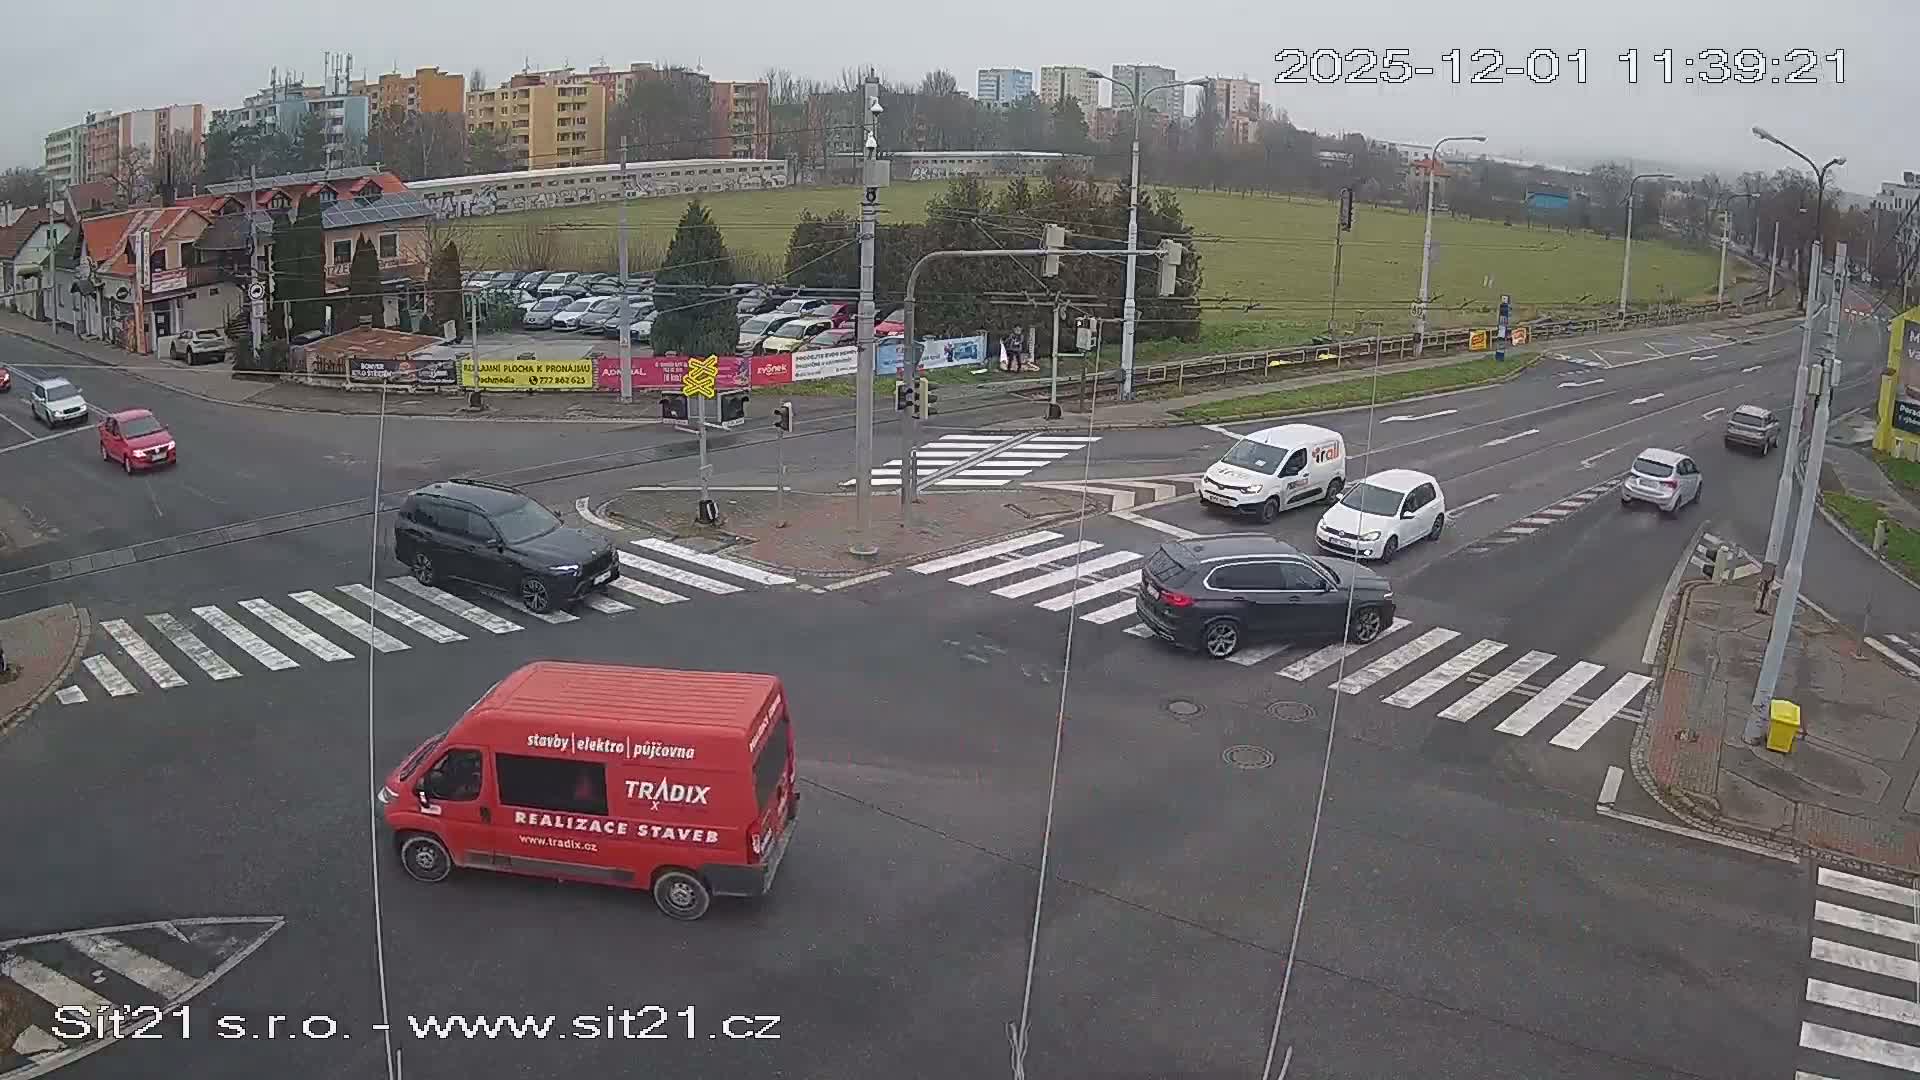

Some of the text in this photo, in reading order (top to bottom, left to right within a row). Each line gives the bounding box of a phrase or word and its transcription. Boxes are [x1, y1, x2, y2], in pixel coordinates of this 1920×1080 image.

[527, 733, 695, 759] stavby elektro půjčovna
[625, 776, 711, 804] TRADIX
[514, 811, 719, 844] REALIZACE STAVEB
[519, 834, 599, 852] www.tradix.cz
